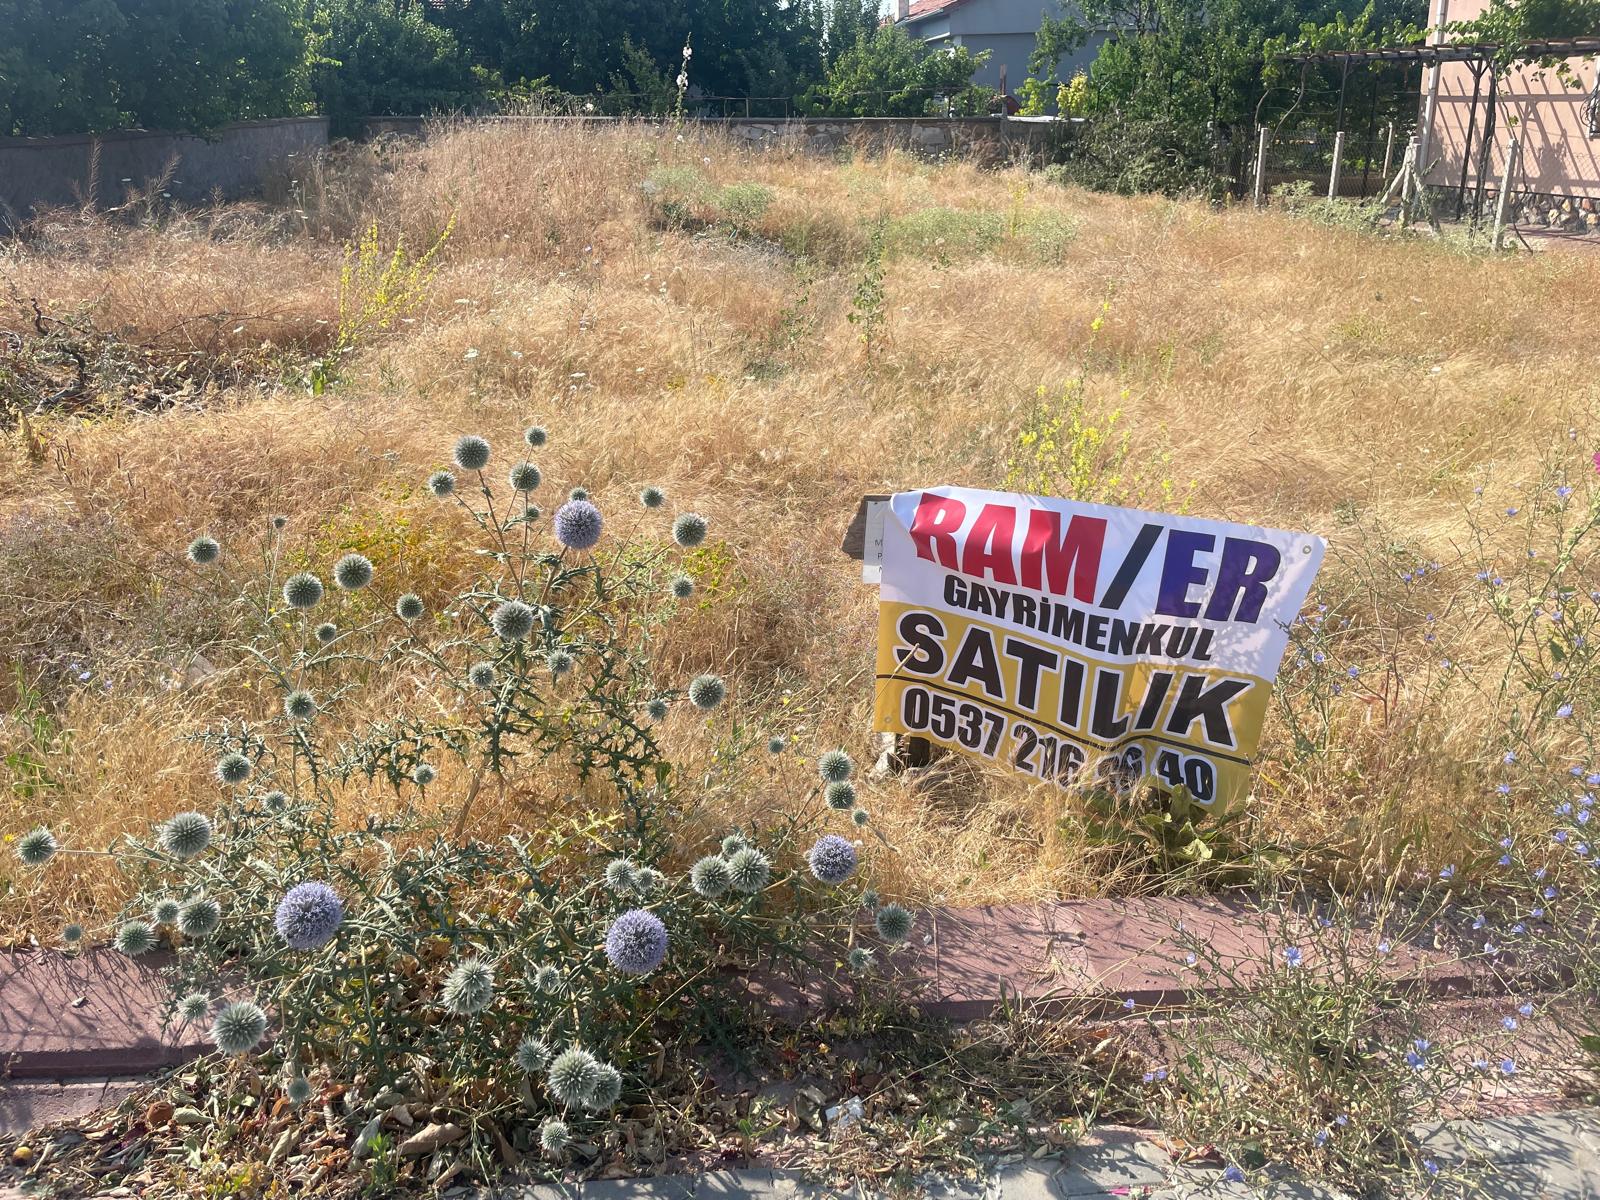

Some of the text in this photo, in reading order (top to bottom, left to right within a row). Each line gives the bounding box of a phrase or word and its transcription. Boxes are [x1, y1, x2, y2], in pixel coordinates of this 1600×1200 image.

[896, 613, 1254, 748] SATILIK
[903, 687, 1005, 757] 0537
[1159, 749, 1214, 802] 40
